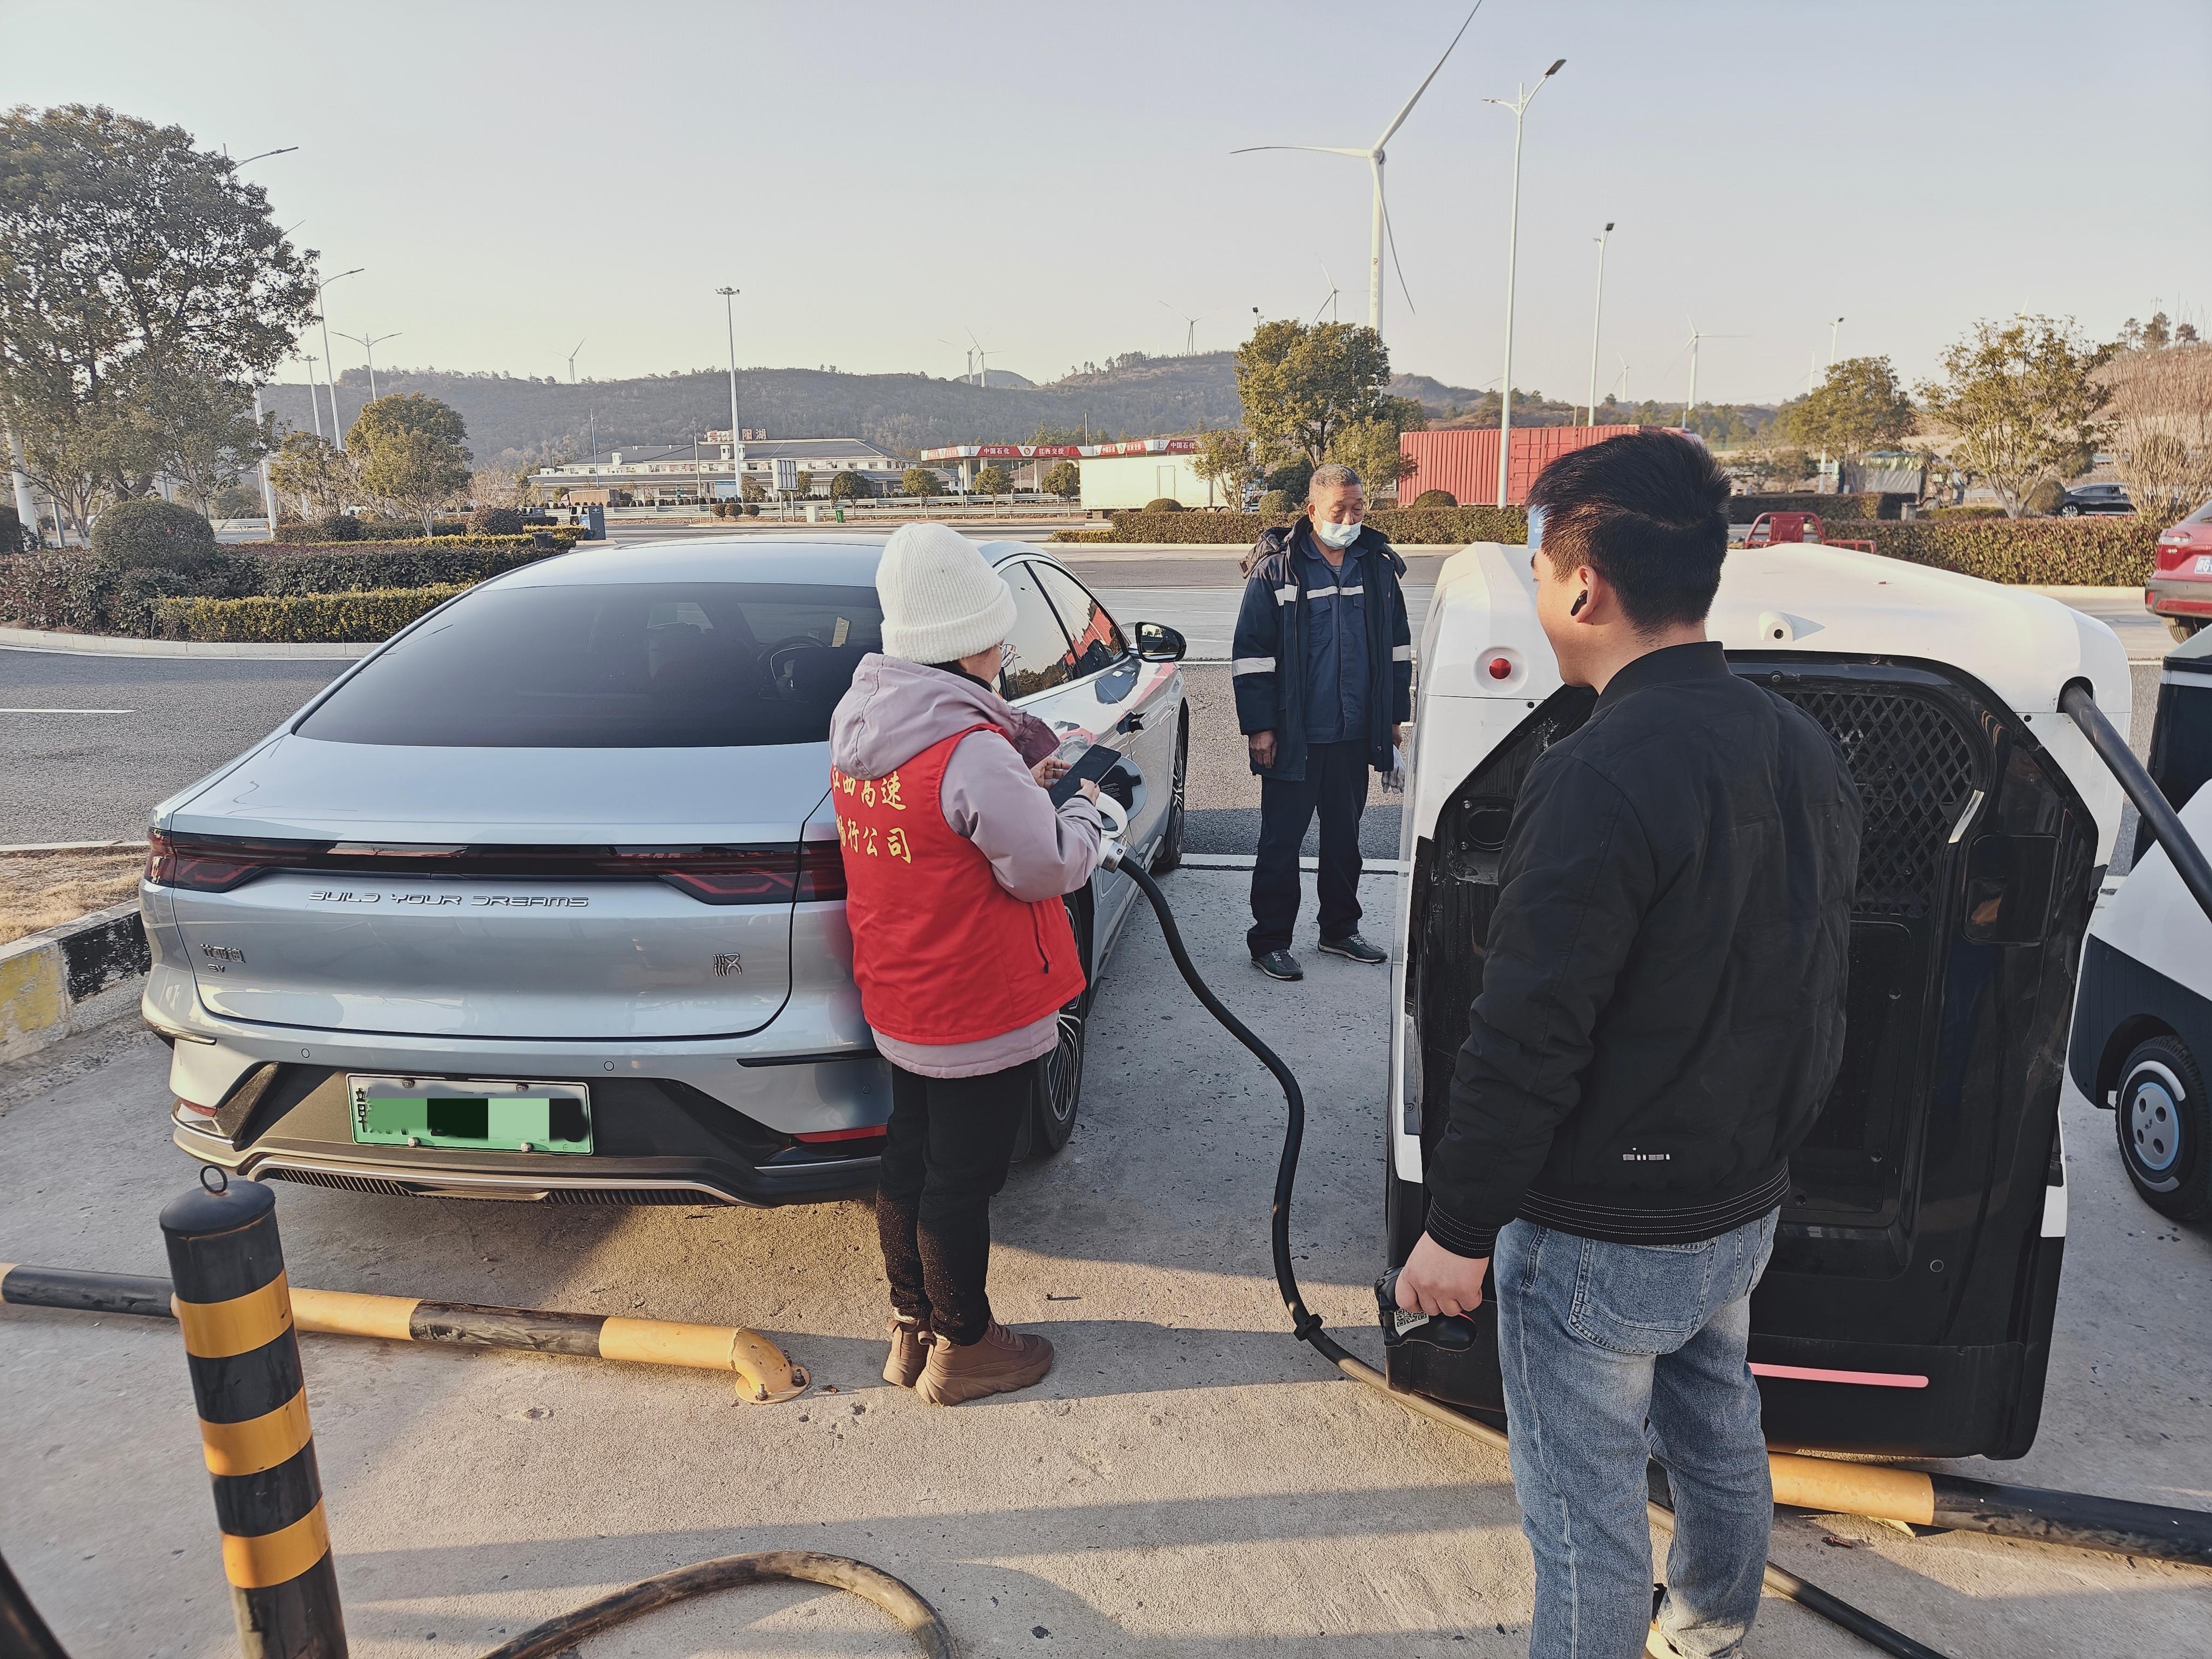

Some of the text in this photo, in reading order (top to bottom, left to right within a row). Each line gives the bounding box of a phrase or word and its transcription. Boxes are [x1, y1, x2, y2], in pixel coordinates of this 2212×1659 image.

[308, 891, 589, 907] BUILD YOUR DREAMS
[207, 963, 225, 972] EV
